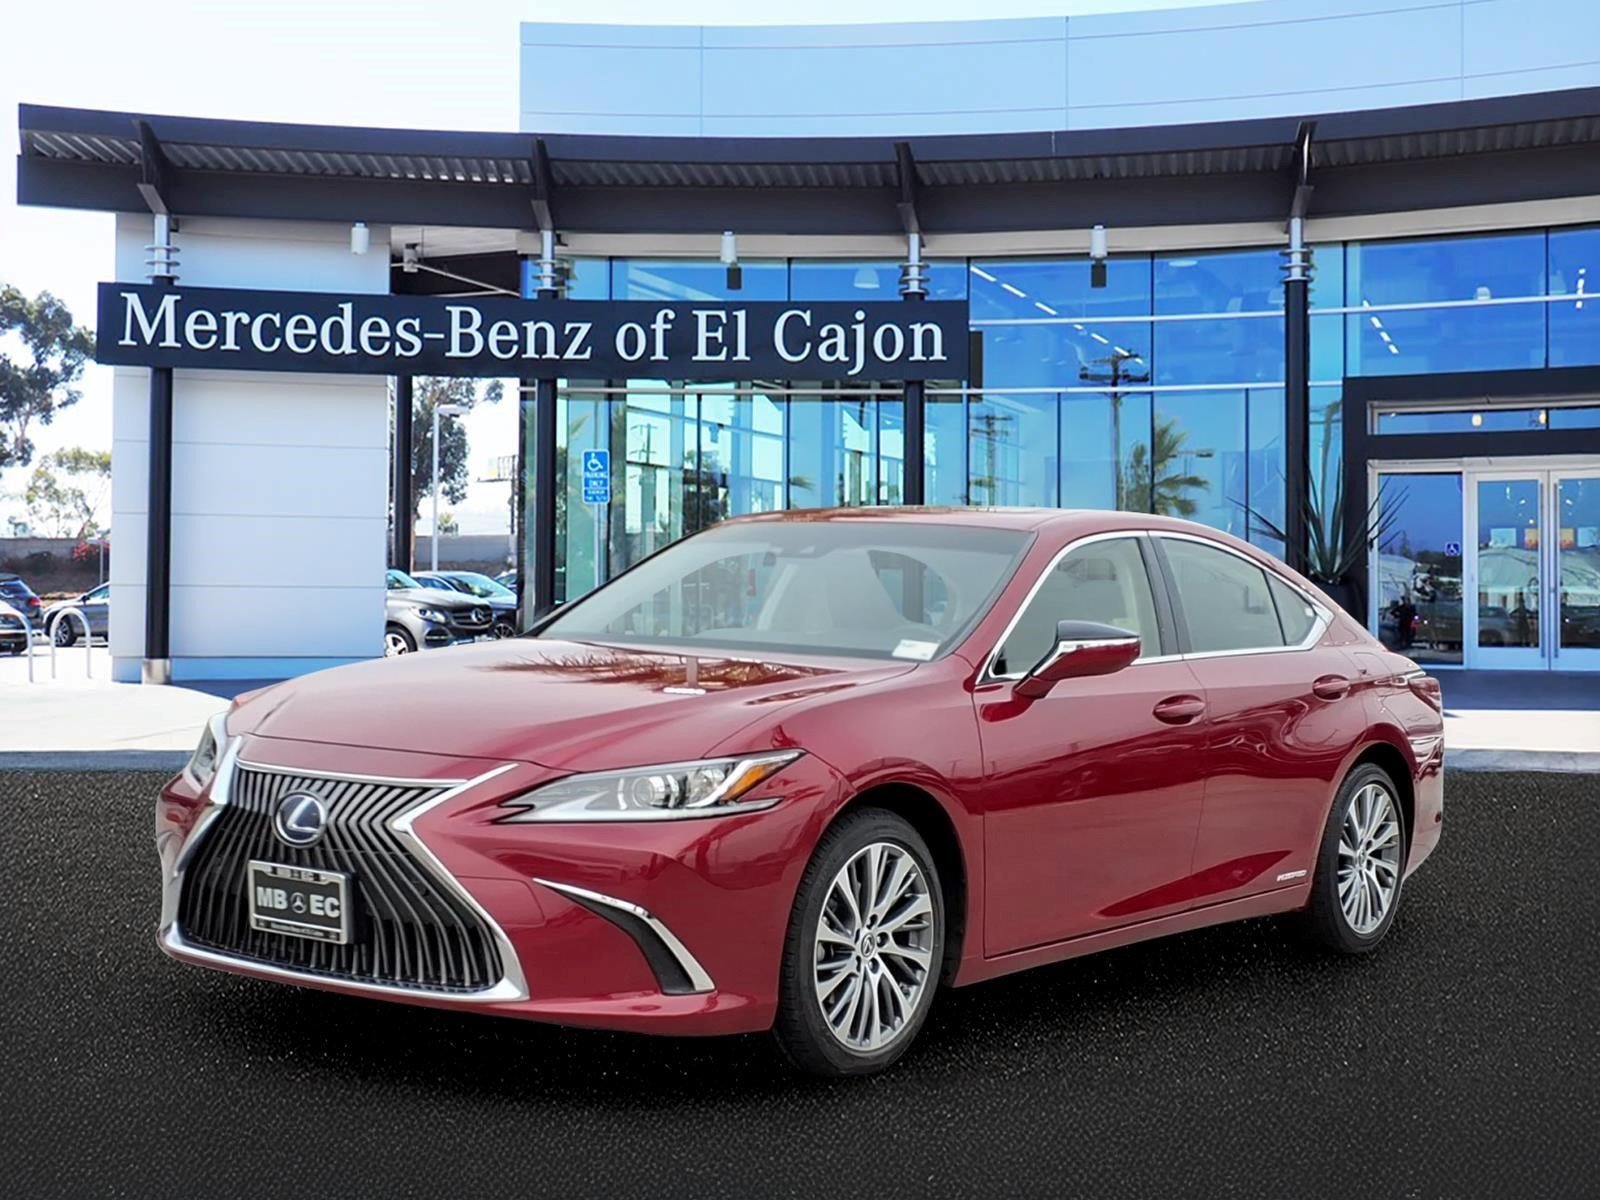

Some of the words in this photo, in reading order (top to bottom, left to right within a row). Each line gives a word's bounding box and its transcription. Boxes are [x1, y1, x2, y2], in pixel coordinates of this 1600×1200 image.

[118, 292, 592, 359] Mercedes-Benz
[615, 309, 676, 361] of
[691, 309, 751, 361] El
[774, 310, 947, 376] Cajon
[256, 886, 289, 910] MB
[309, 894, 340, 918] EC
